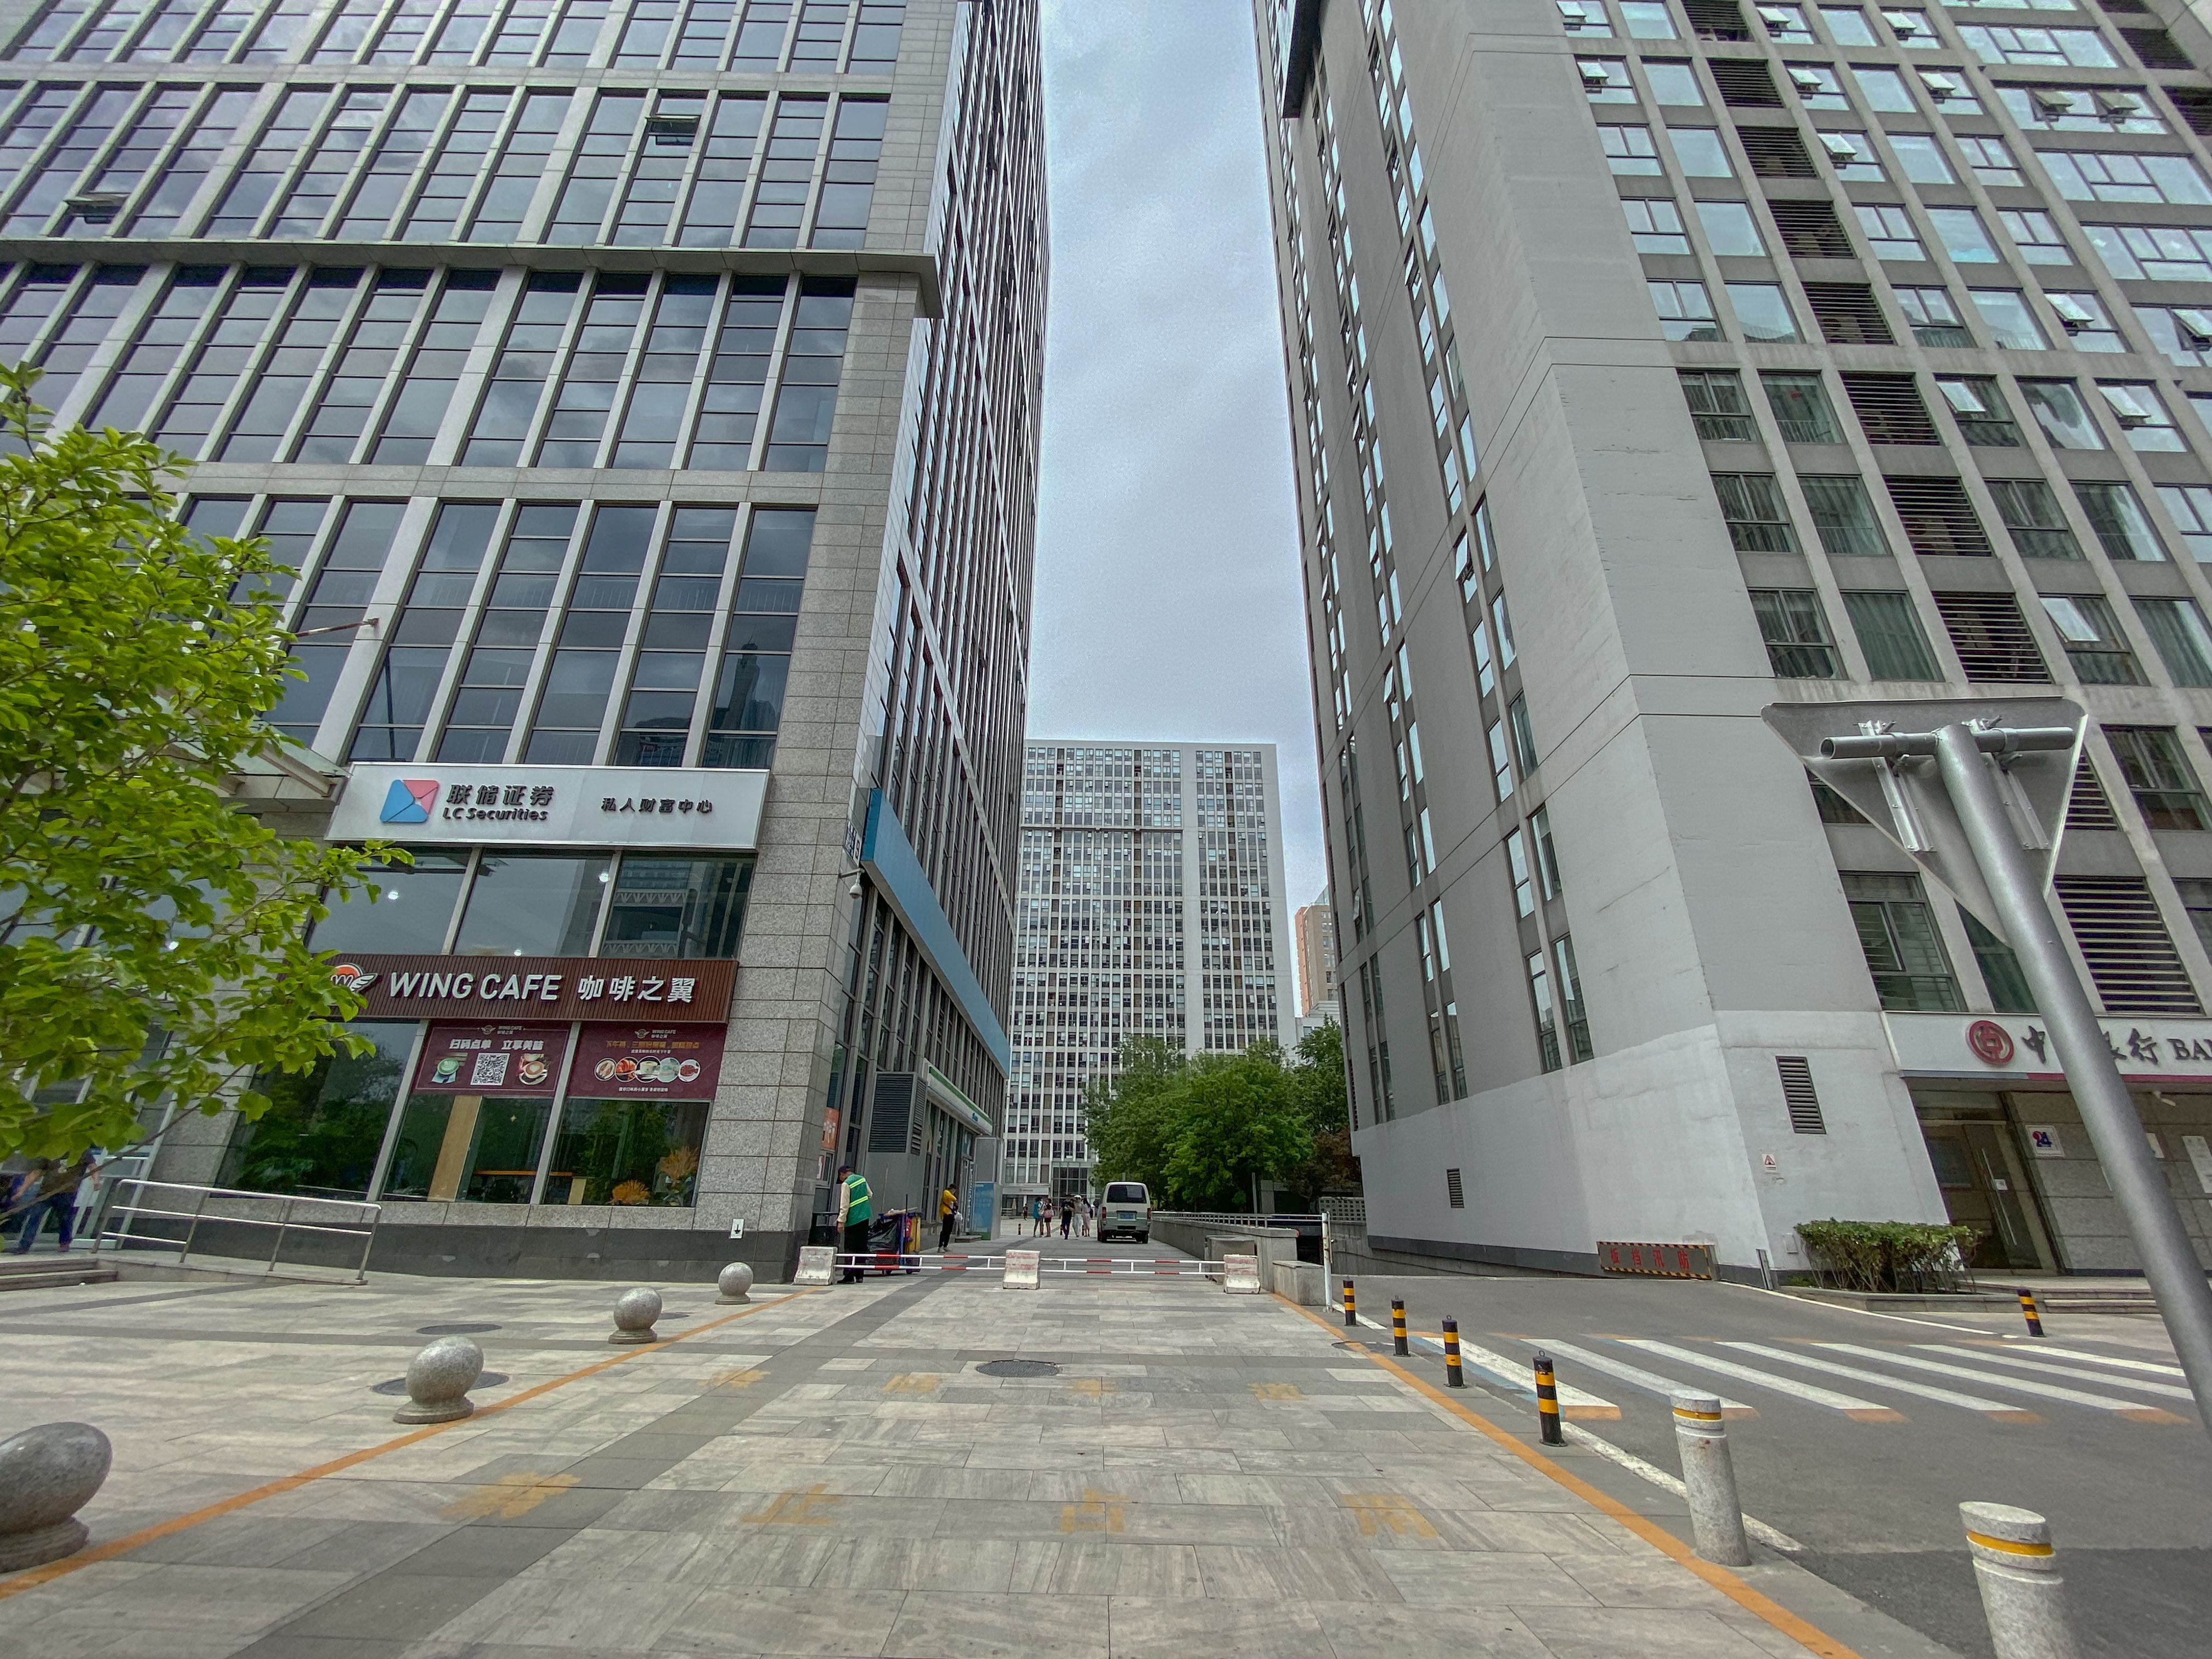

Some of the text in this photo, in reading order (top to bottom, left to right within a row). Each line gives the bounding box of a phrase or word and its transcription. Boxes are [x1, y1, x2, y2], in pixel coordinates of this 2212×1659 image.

[447, 784, 554, 806] 联储证券
[601, 797, 712, 814] 私人财富中心
[442, 807, 549, 821] LC Securities
[390, 972, 563, 1001] WING CAFE
[577, 975, 696, 1003] 咖啡之翼
